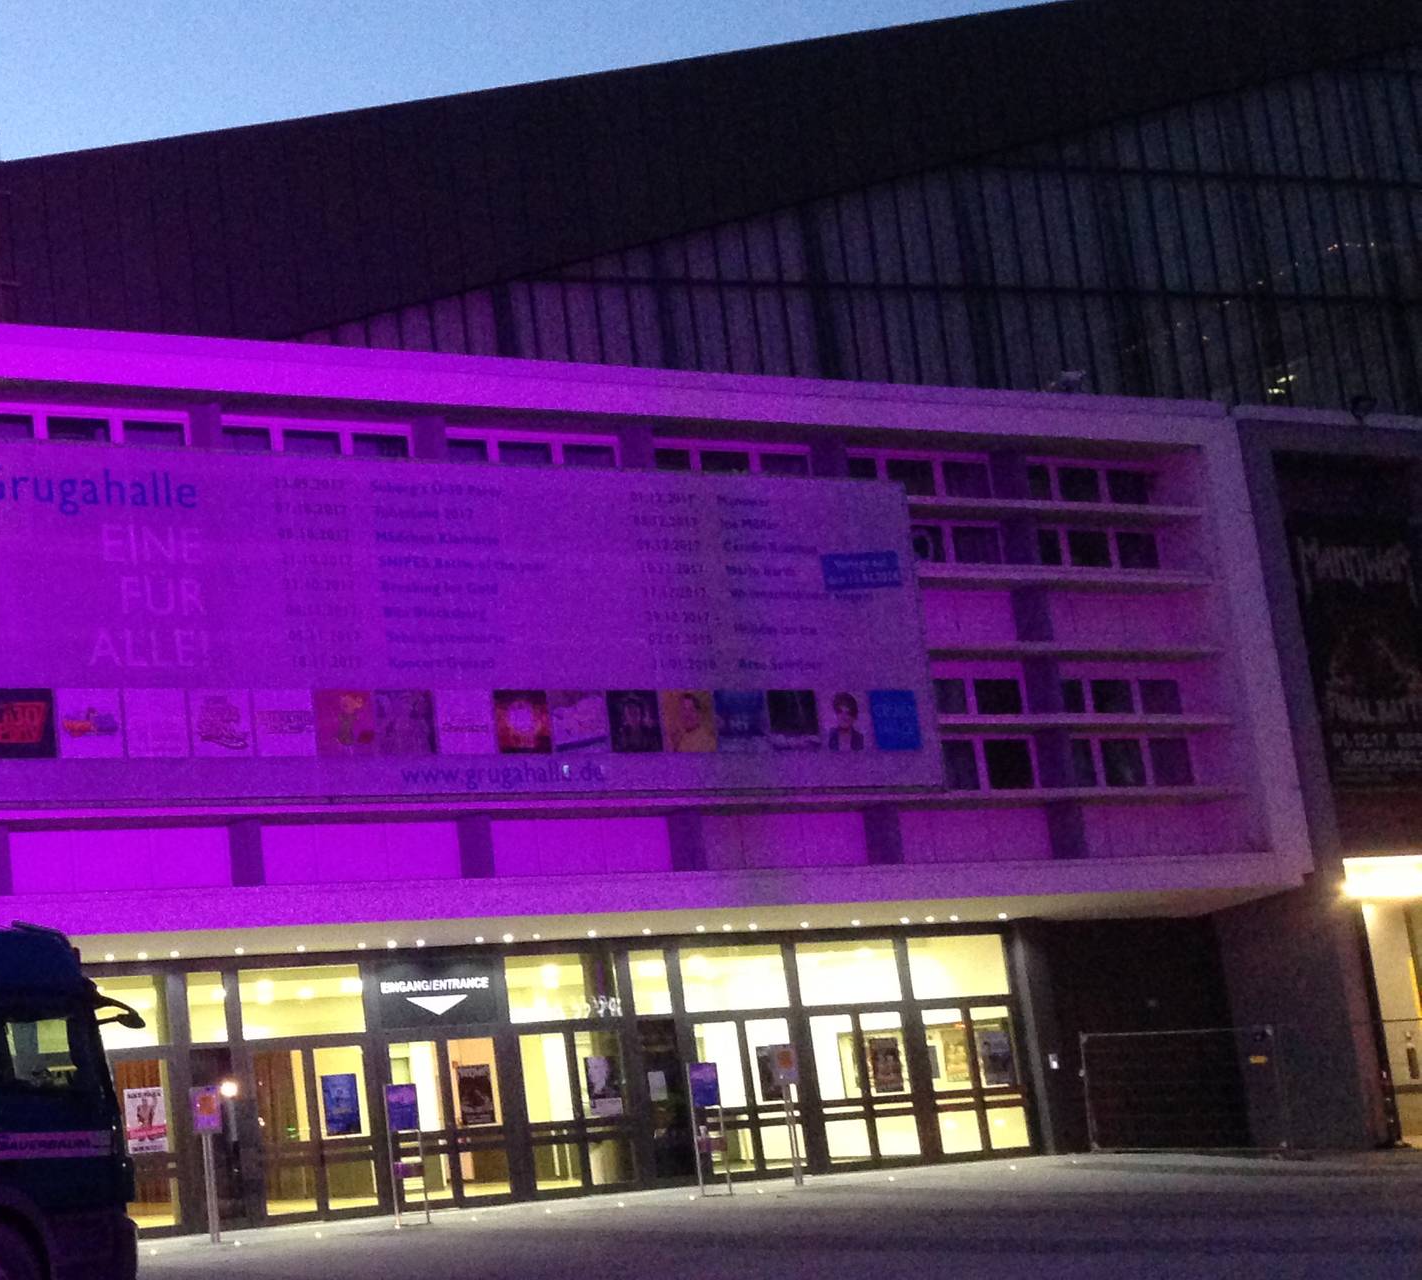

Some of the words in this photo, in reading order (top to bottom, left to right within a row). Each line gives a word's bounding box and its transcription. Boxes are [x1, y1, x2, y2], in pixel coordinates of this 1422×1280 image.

[101, 524, 203, 564] EINE
[121, 570, 208, 616] FÜR
[86, 628, 210, 668] ALLE!
[401, 761, 604, 790] www.grugahalle.de
[380, 977, 490, 994] EINGANG/ENTRANCE
